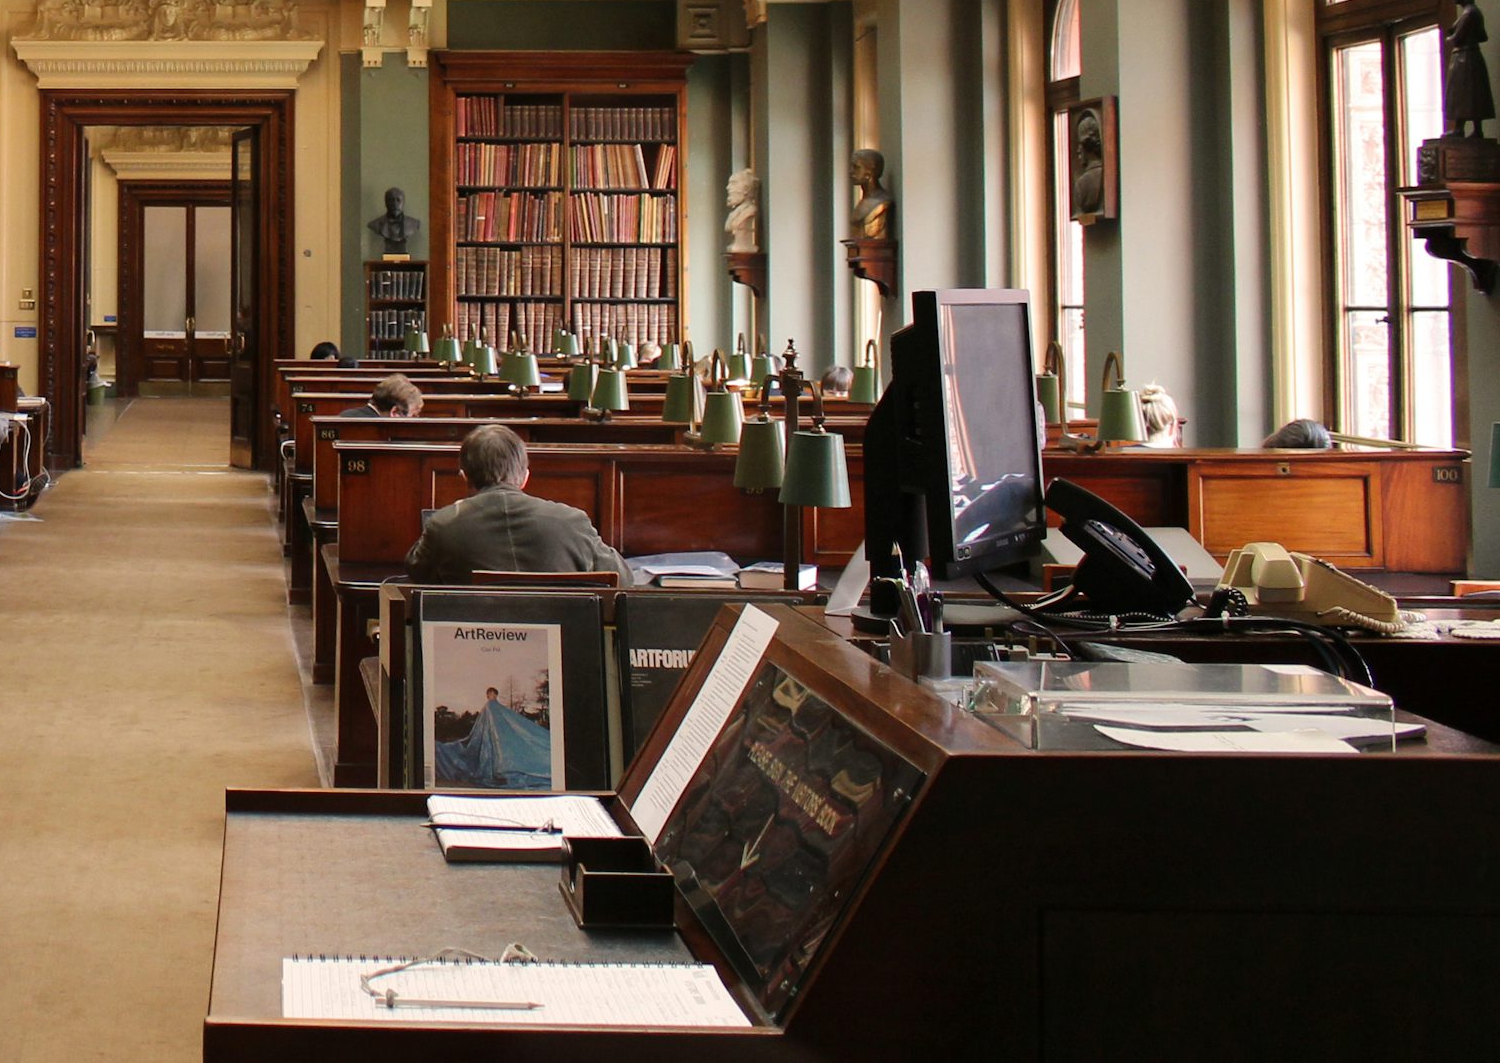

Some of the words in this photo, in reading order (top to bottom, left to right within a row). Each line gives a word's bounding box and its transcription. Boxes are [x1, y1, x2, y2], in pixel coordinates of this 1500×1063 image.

[301, 404, 312, 412] 74
[320, 430, 334, 439] 86
[347, 460, 364, 472] 98
[1436, 469, 1457, 481] 100
[454, 627, 527, 641] ArtReview
[630, 649, 697, 669] ARTFORU
